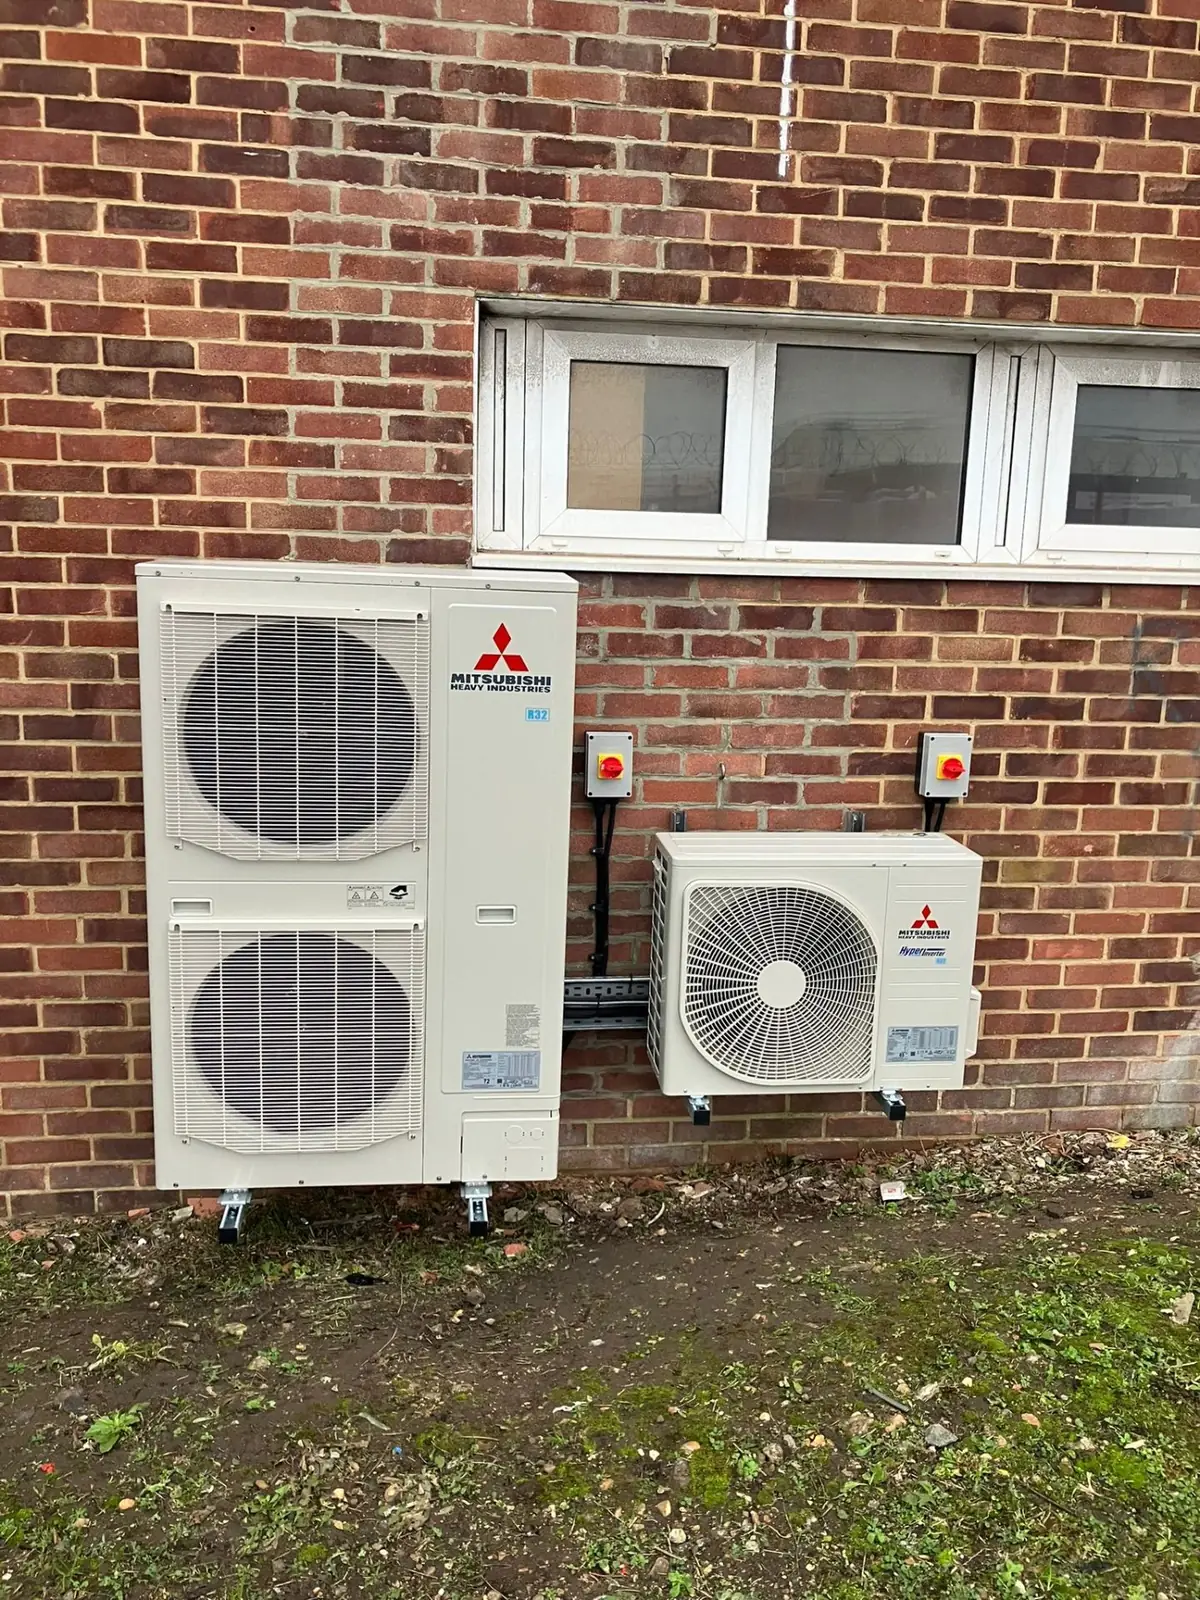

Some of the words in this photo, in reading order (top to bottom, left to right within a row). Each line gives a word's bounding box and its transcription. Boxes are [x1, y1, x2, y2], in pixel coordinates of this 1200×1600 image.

[451, 673, 551, 686] MITSUBISHI
[487, 684, 551, 693] INDUSTRIES
[527, 709, 548, 720] R32
[900, 946, 924, 956] Hyper
[921, 948, 946, 956] Inverter
